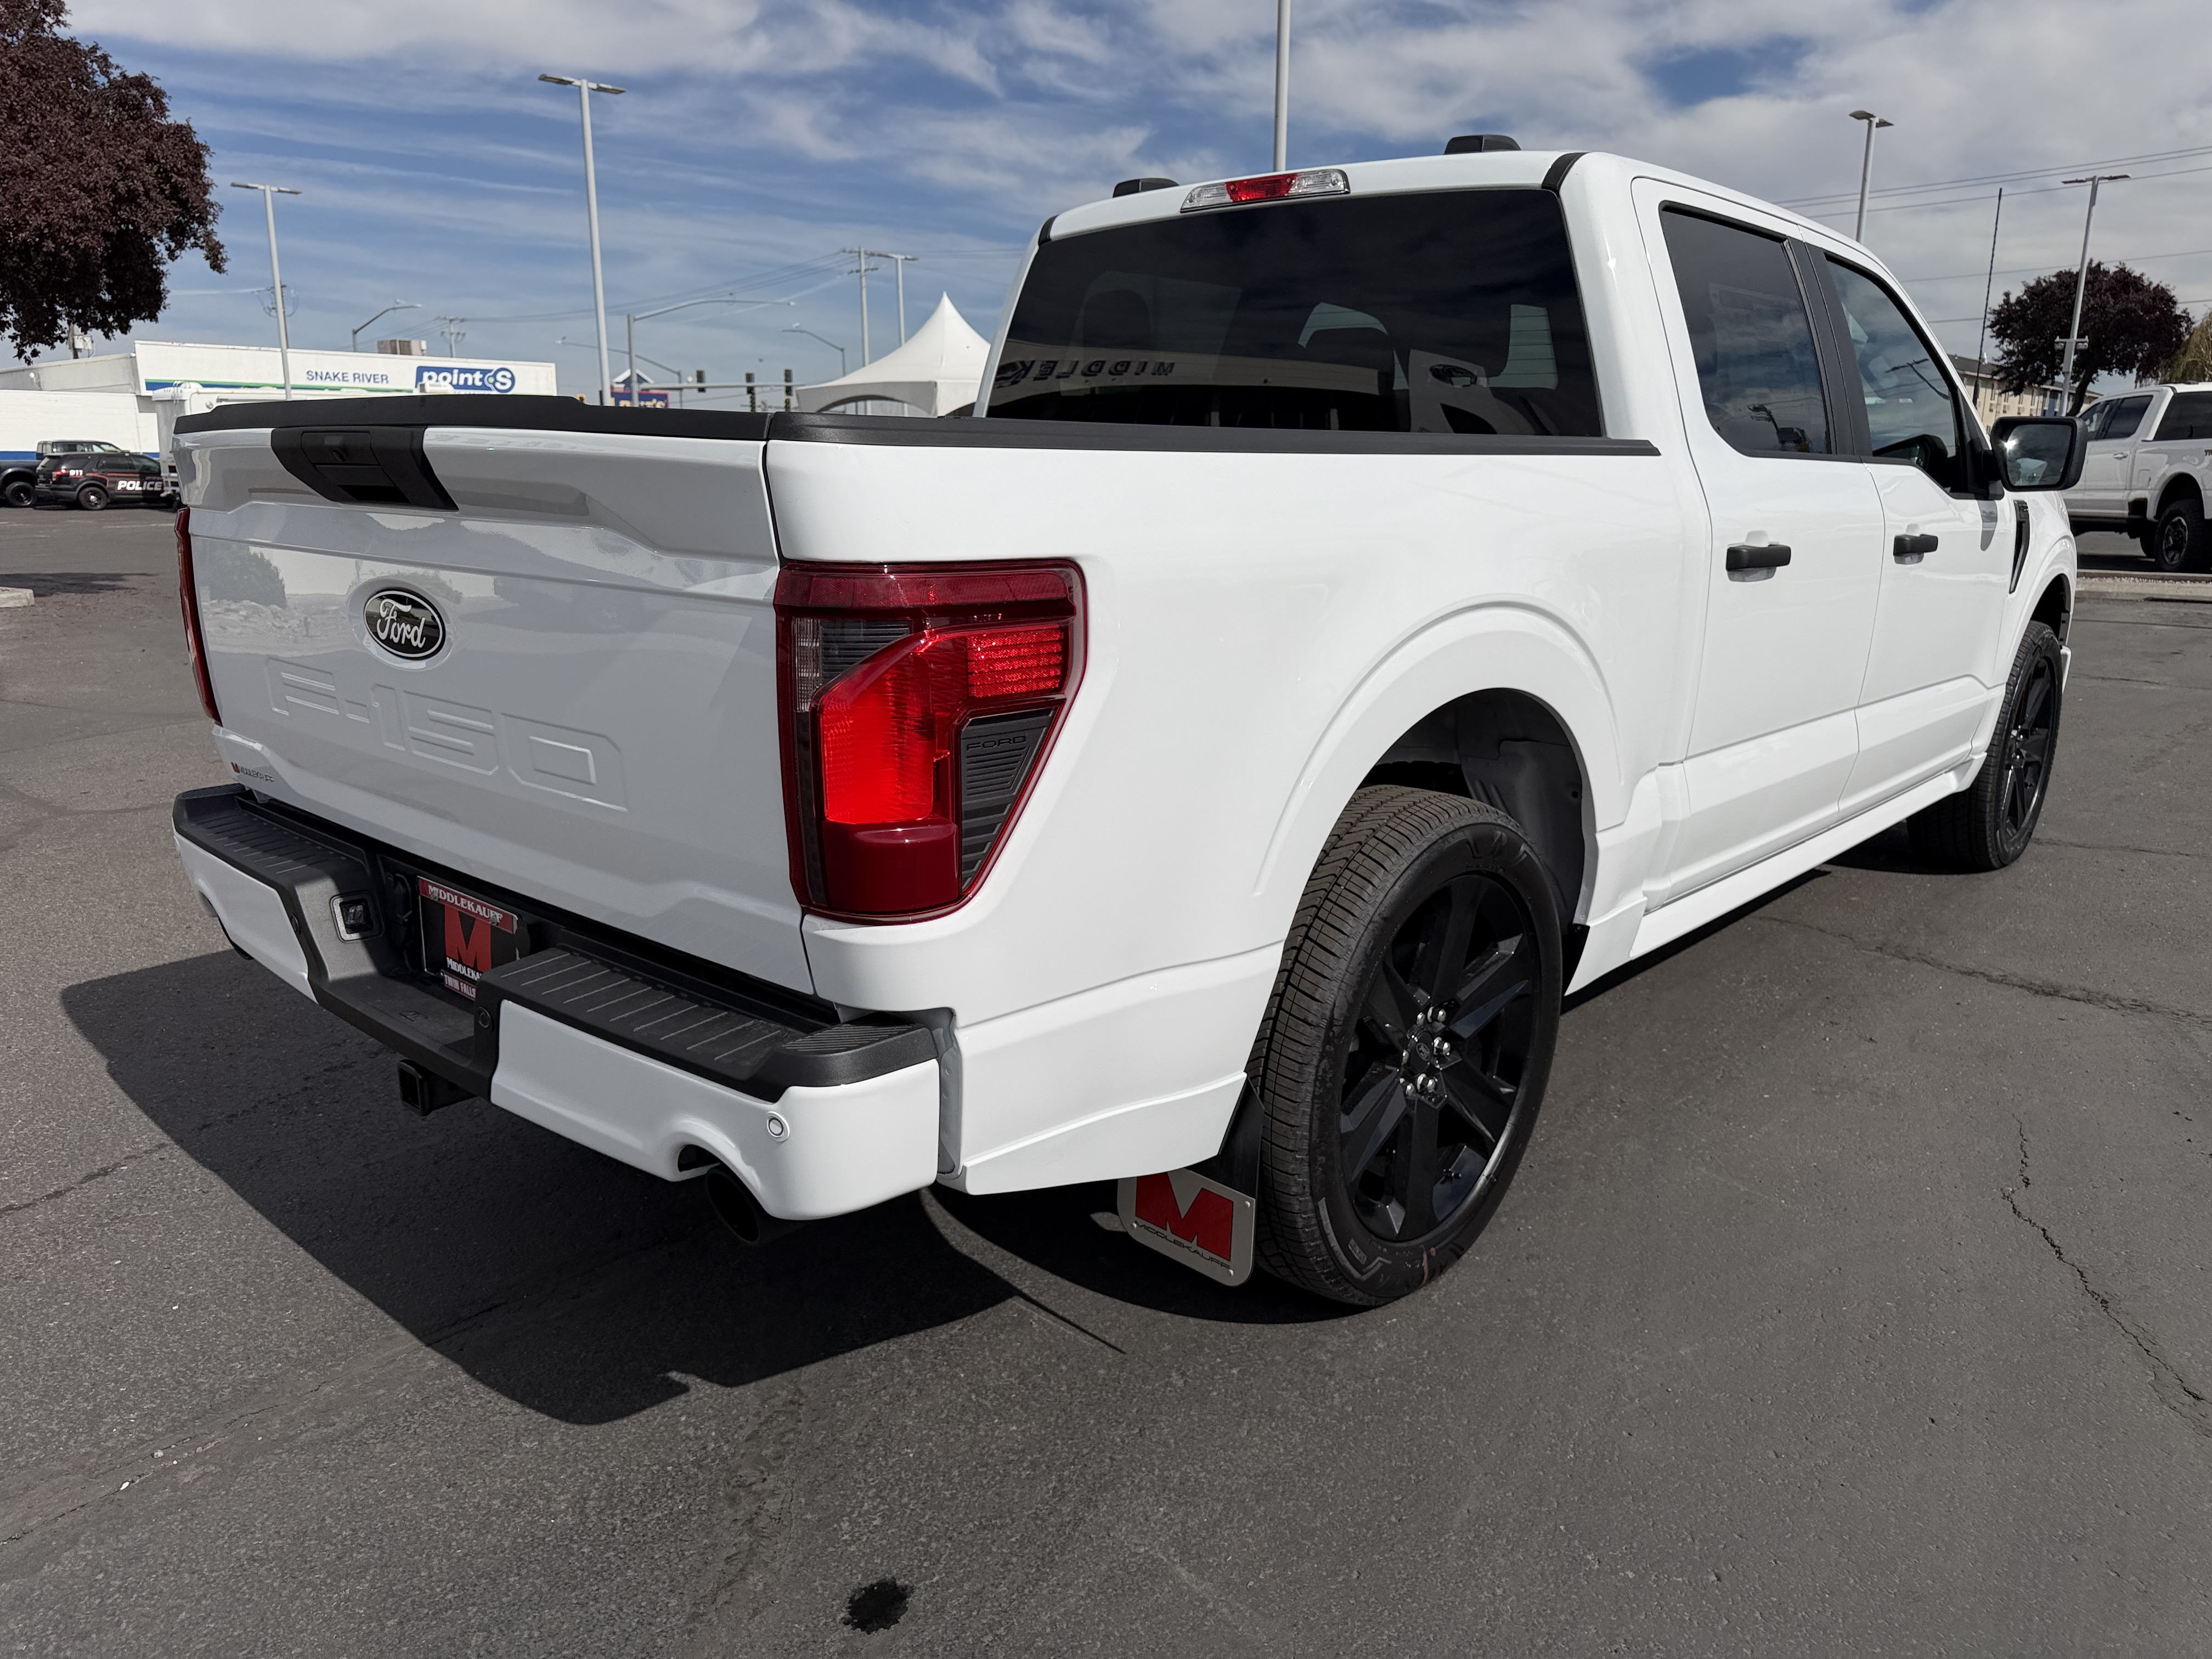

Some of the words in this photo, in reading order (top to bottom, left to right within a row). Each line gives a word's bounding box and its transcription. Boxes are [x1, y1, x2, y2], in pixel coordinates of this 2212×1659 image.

[306, 370, 349, 382] SNAKE
[353, 373, 389, 384] RIVER
[117, 480, 163, 491] POLICE
[376, 599, 426, 648] Ford
[264, 657, 628, 811] F-150
[966, 735, 1026, 751] FORD
[428, 884, 504, 923] MIDDLEKAUFF
[444, 905, 492, 972] M
[446, 956, 482, 981] MIDDLEKA
[444, 974, 460, 991] TWIN
[460, 981, 476, 998] FALLS
[1134, 1220, 1231, 1269] MIDDLEKAUFF
